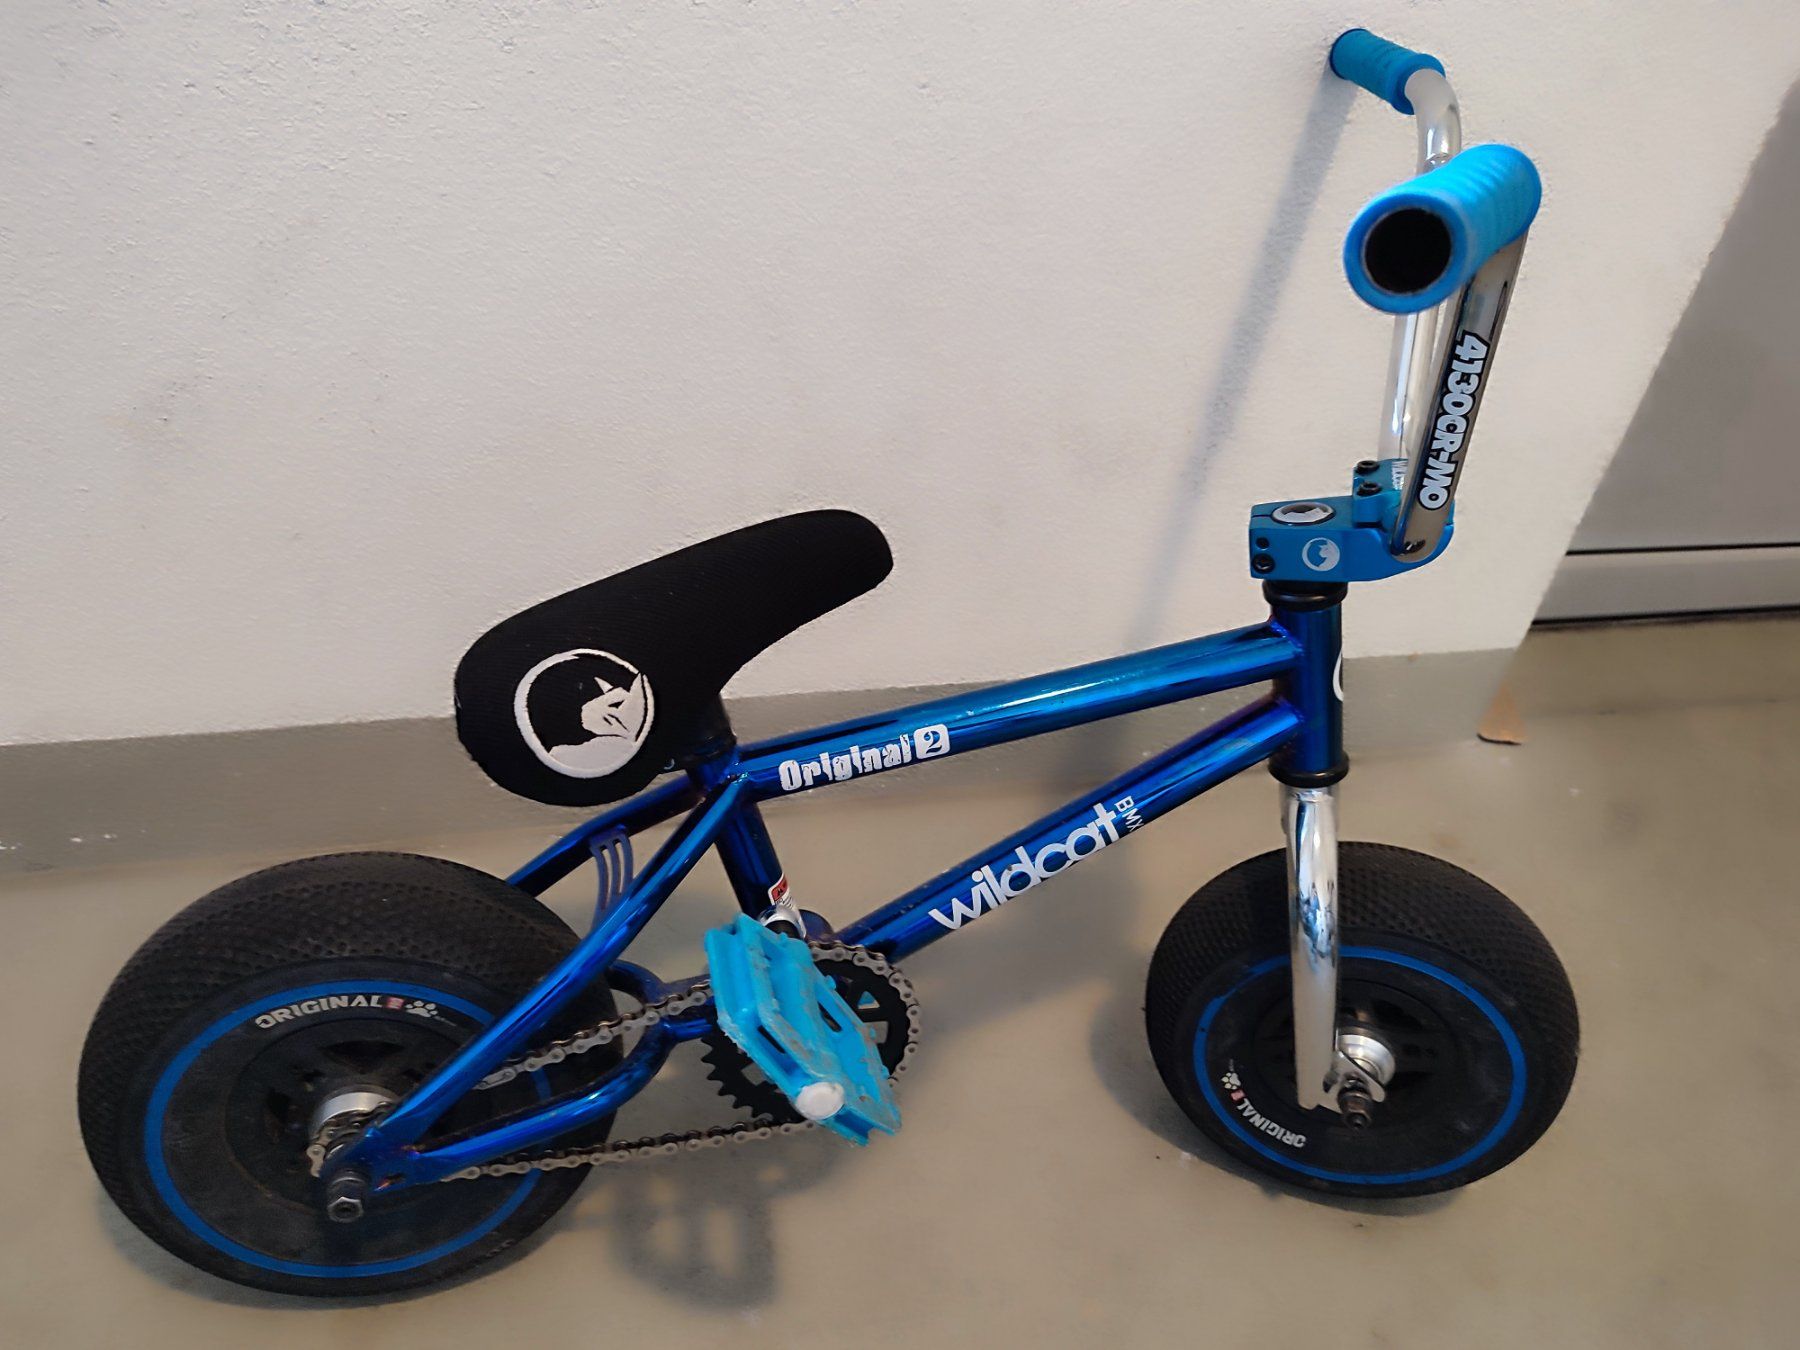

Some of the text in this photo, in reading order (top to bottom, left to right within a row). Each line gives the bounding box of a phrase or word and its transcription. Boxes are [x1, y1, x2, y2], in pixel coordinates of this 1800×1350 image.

[1419, 332, 1489, 511] 4130CR-MO
[778, 734, 911, 791] Original
[928, 795, 1144, 930] wildcat BMX
[254, 995, 383, 1029] ORIGINAL
[1237, 1098, 1306, 1148] ORIGINAL
